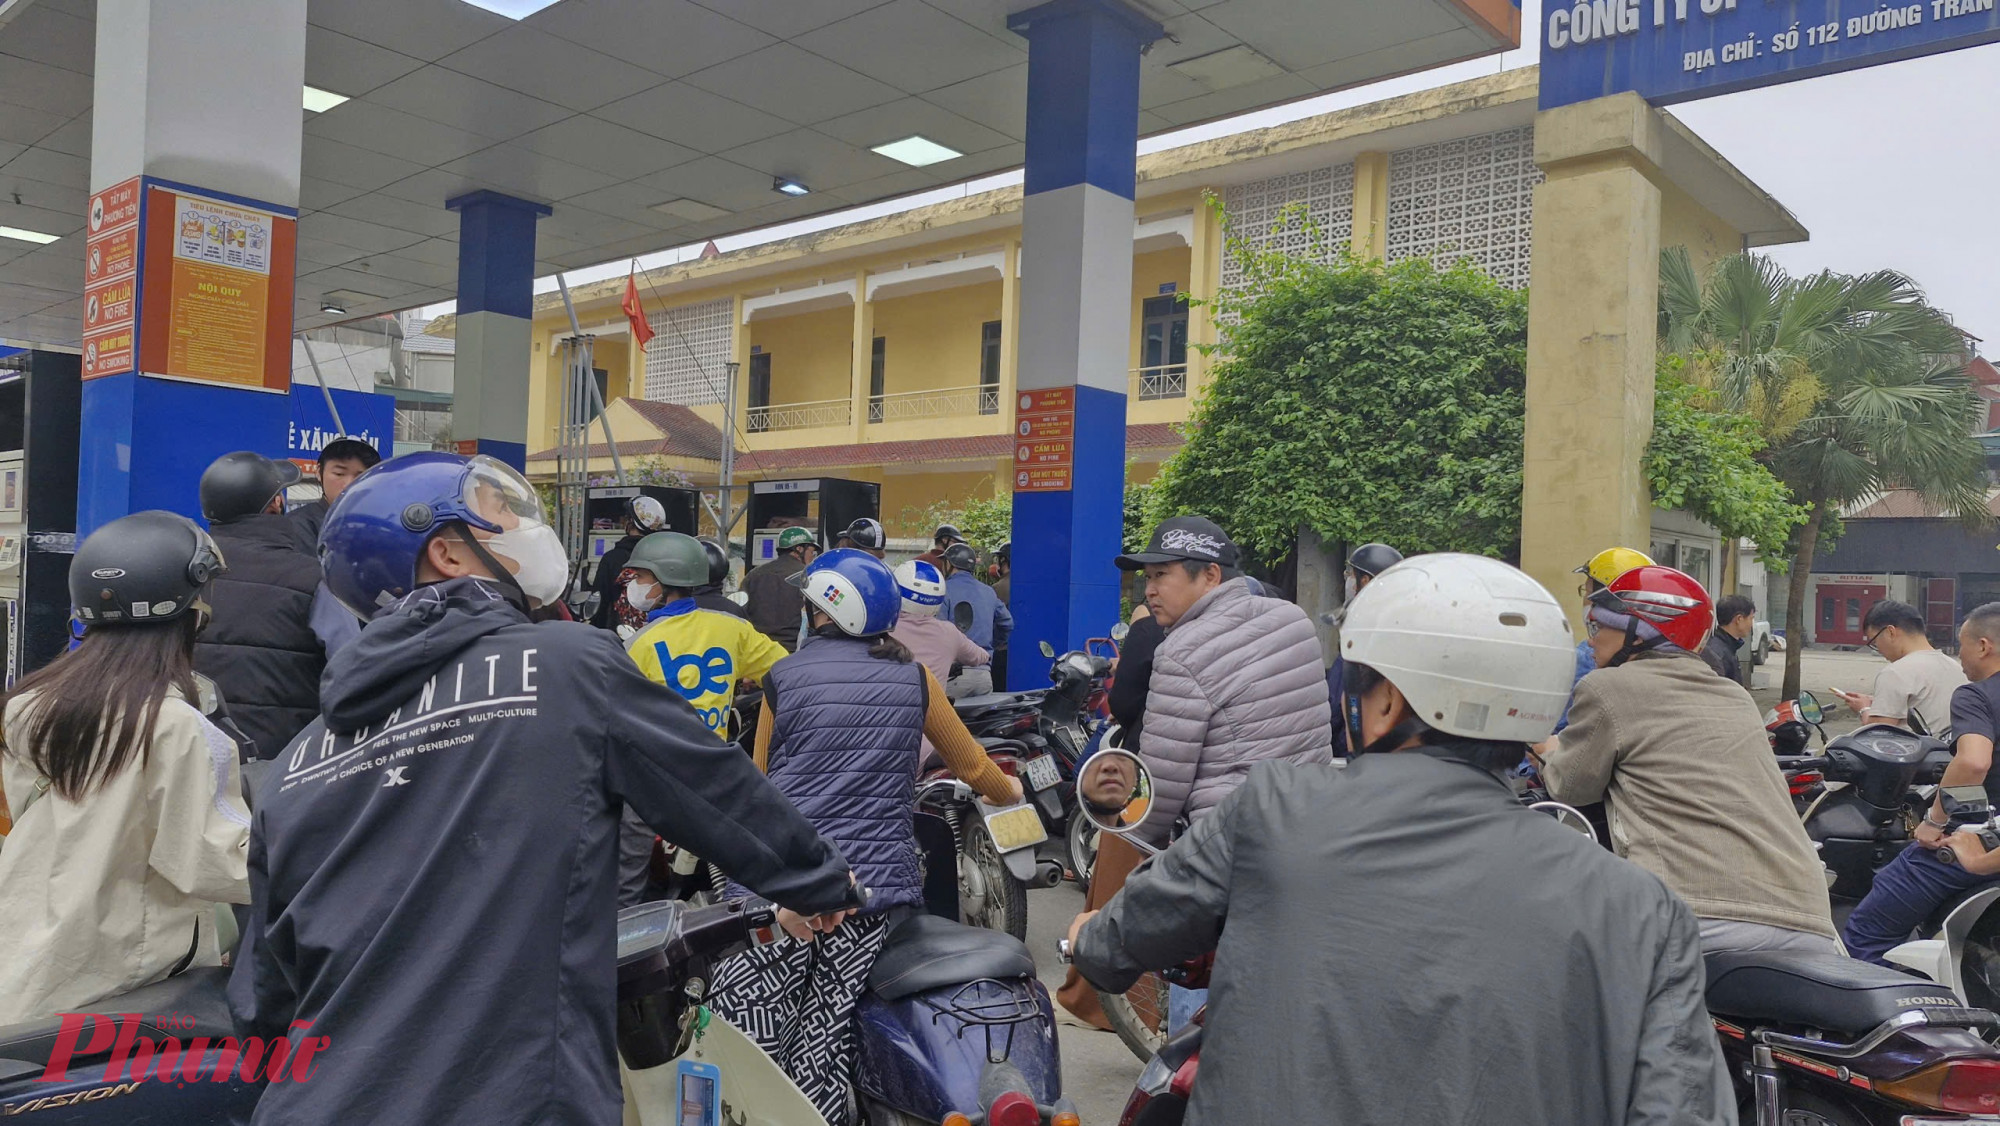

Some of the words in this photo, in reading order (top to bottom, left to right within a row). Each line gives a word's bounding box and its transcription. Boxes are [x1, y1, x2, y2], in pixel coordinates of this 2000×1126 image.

[1548, 0, 1640, 49] CÔNG
[1683, 51, 1715, 73] ĐỊA
[1771, 22, 1799, 54] SỐ
[1806, 23, 1839, 46] 112
[1847, 3, 1922, 39] ĐƯỜNG
[198, 282, 217, 293] NỘI
[220, 286, 242, 297] QUY
[104, 307, 113, 320] NO
[114, 304, 128, 317] FIRE
[288, 421, 296, 449] Ẻ
[654, 640, 733, 700] be
[372, 738, 390, 749] FEEL
[392, 732, 407, 742] THE
[409, 725, 428, 738] NEW
[430, 718, 461, 732] SPACE
[468, 708, 538, 723] MULTI-CULTURE
[340, 761, 373, 779] CHOICE
[375, 755, 388, 766] OF
[389, 754, 395, 762] A
[395, 746, 415, 759] NEW
[417, 733, 475, 753] GENERATION
[1895, 996, 1959, 1007] HONDA
[5, 1081, 143, 1116] VISION
